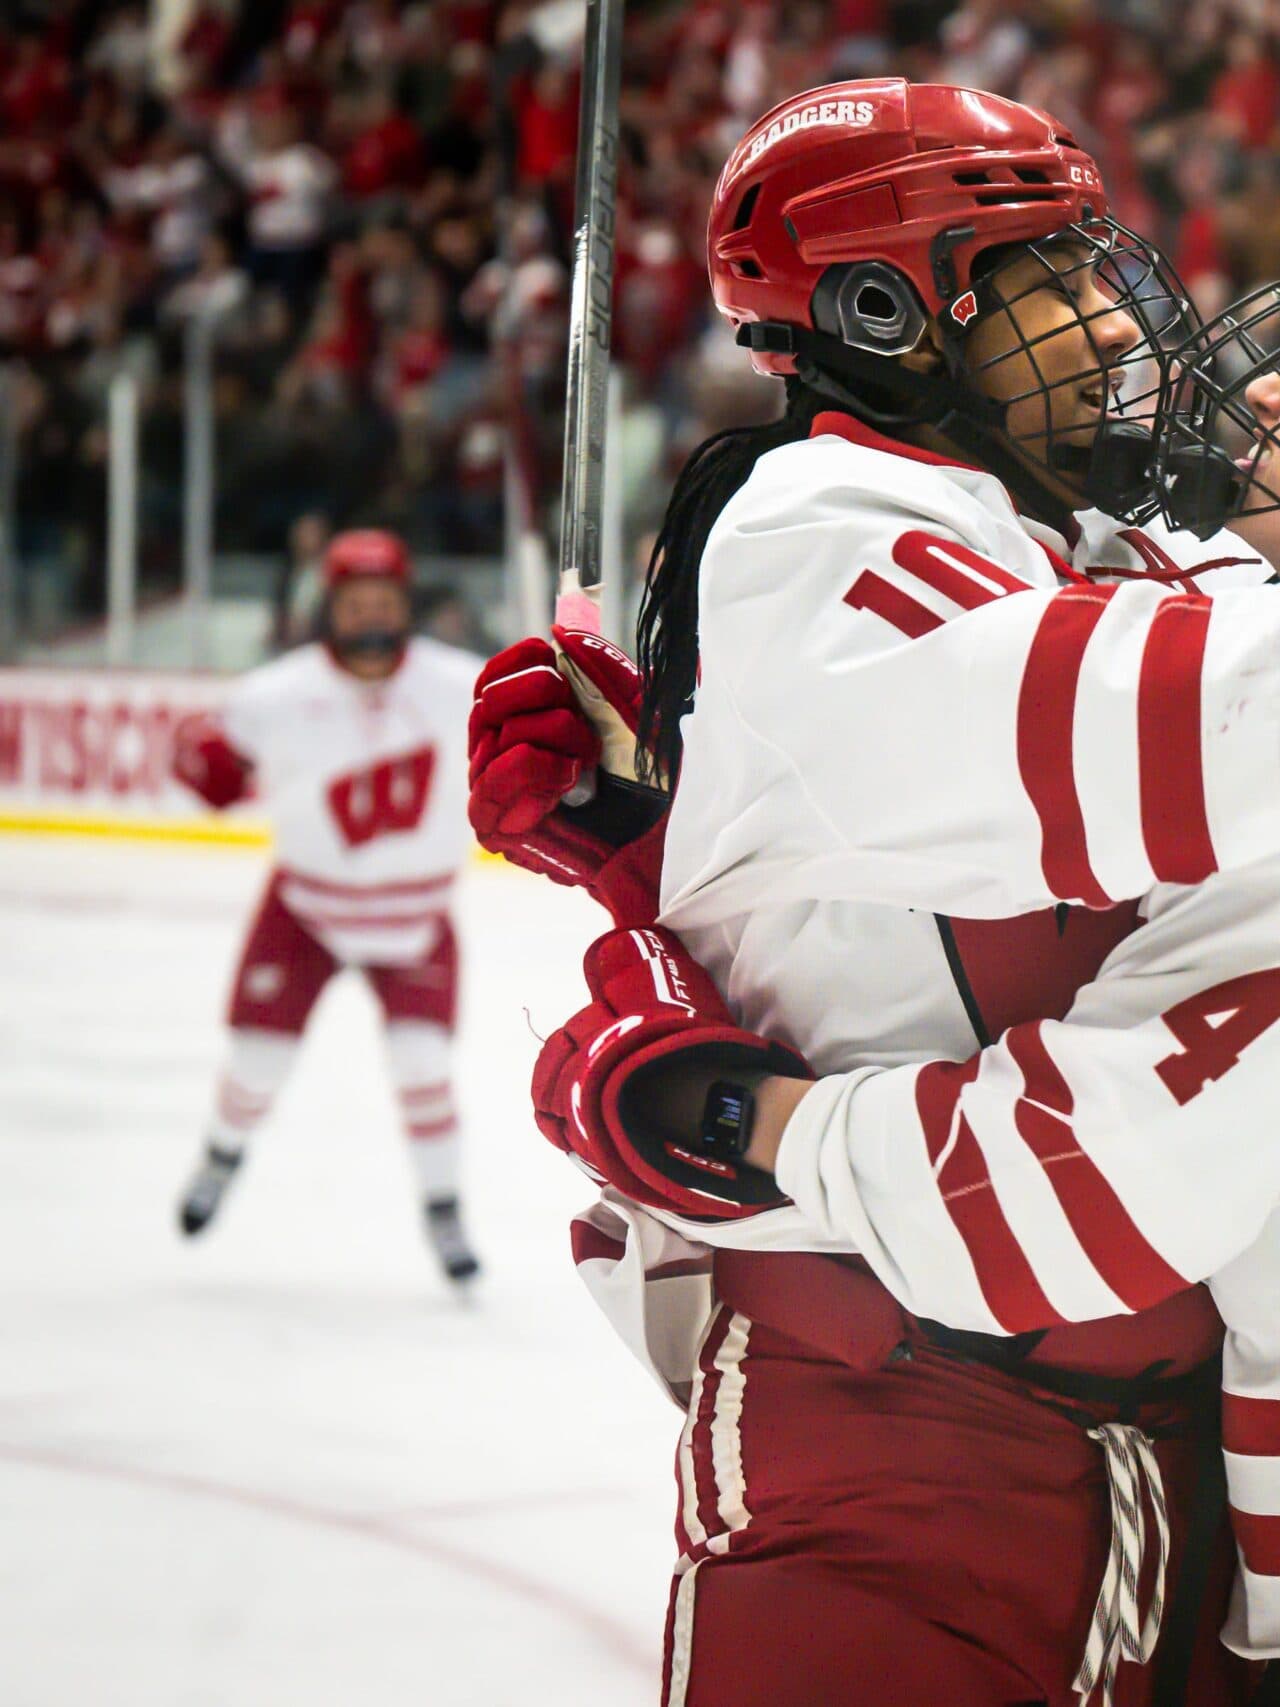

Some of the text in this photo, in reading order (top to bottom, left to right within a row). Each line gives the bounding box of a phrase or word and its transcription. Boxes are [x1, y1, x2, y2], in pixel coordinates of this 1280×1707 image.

[744, 101, 874, 170] BADGERS
[842, 530, 1034, 640] 10
[327, 740, 440, 849] W
